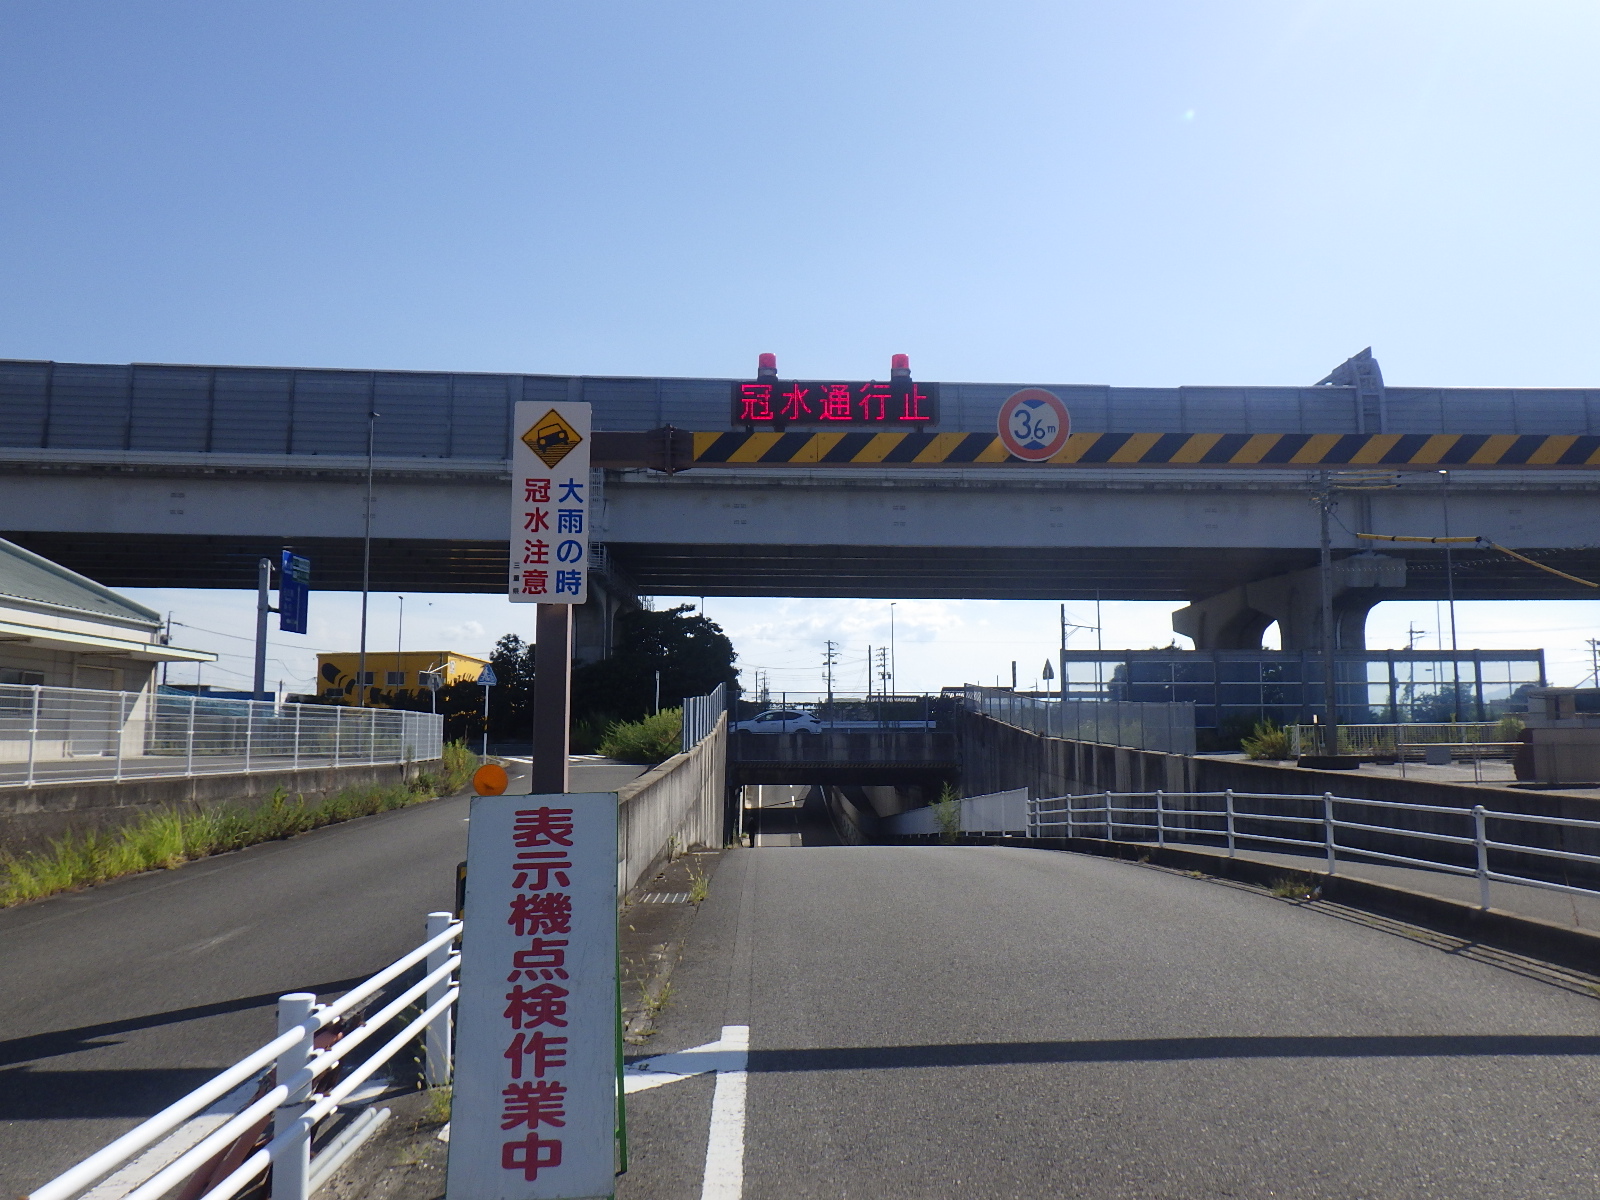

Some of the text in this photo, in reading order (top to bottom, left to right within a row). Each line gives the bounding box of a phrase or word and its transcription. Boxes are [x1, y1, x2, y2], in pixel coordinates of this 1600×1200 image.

[740, 383, 930, 421] 冠水通行止
[1014, 409, 1056, 440] 3.6m
[522, 478, 551, 595] 冠水注意
[555, 477, 584, 596] 大雨の時
[500, 806, 574, 1182] 表示機点検作業中
